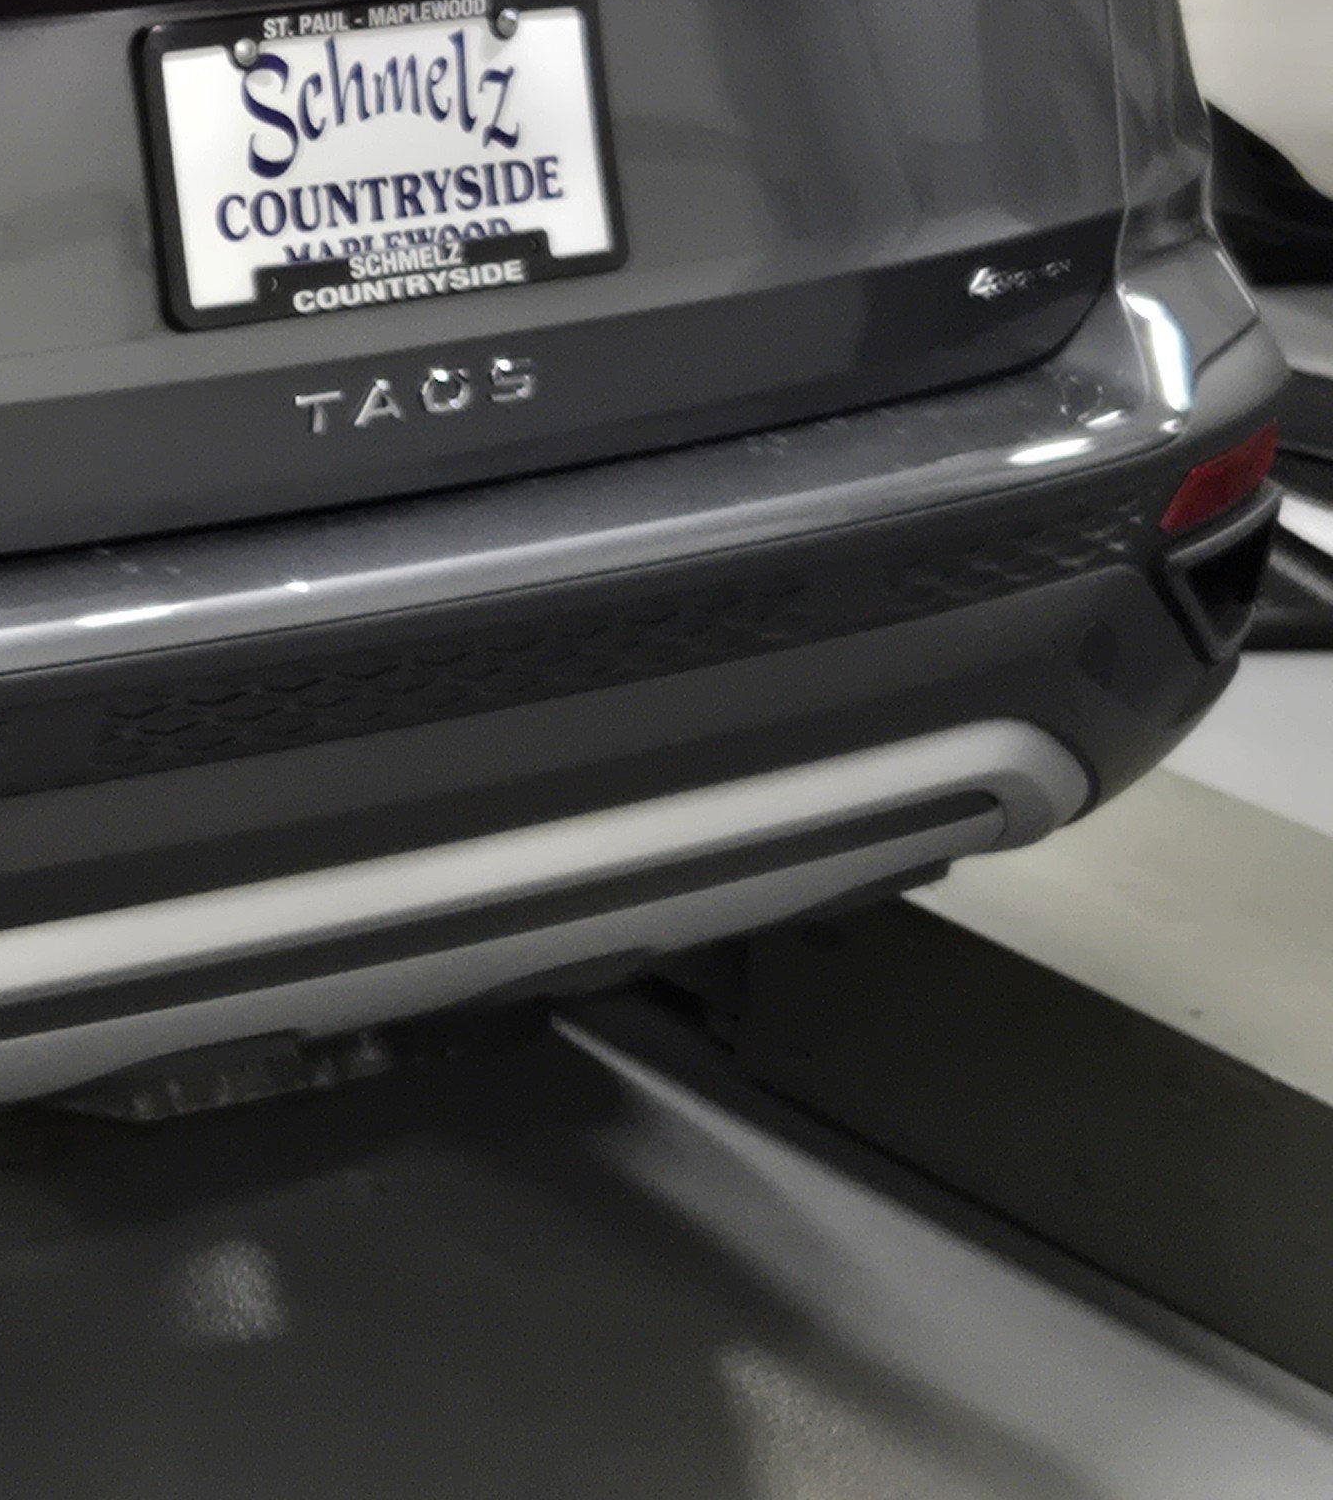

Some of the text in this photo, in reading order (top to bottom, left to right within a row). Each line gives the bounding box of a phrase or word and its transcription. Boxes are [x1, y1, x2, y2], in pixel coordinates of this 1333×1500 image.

[263, 17, 294, 40] ST.
[299, 11, 349, 35] PAUL
[240, 29, 520, 180] Schmelz
[215, 156, 565, 243] COUNTRYSIDE
[292, 259, 527, 314] COUNTRYSIDE
[349, 241, 464, 280] SCHMELZ
[294, 357, 534, 434] TAOS
